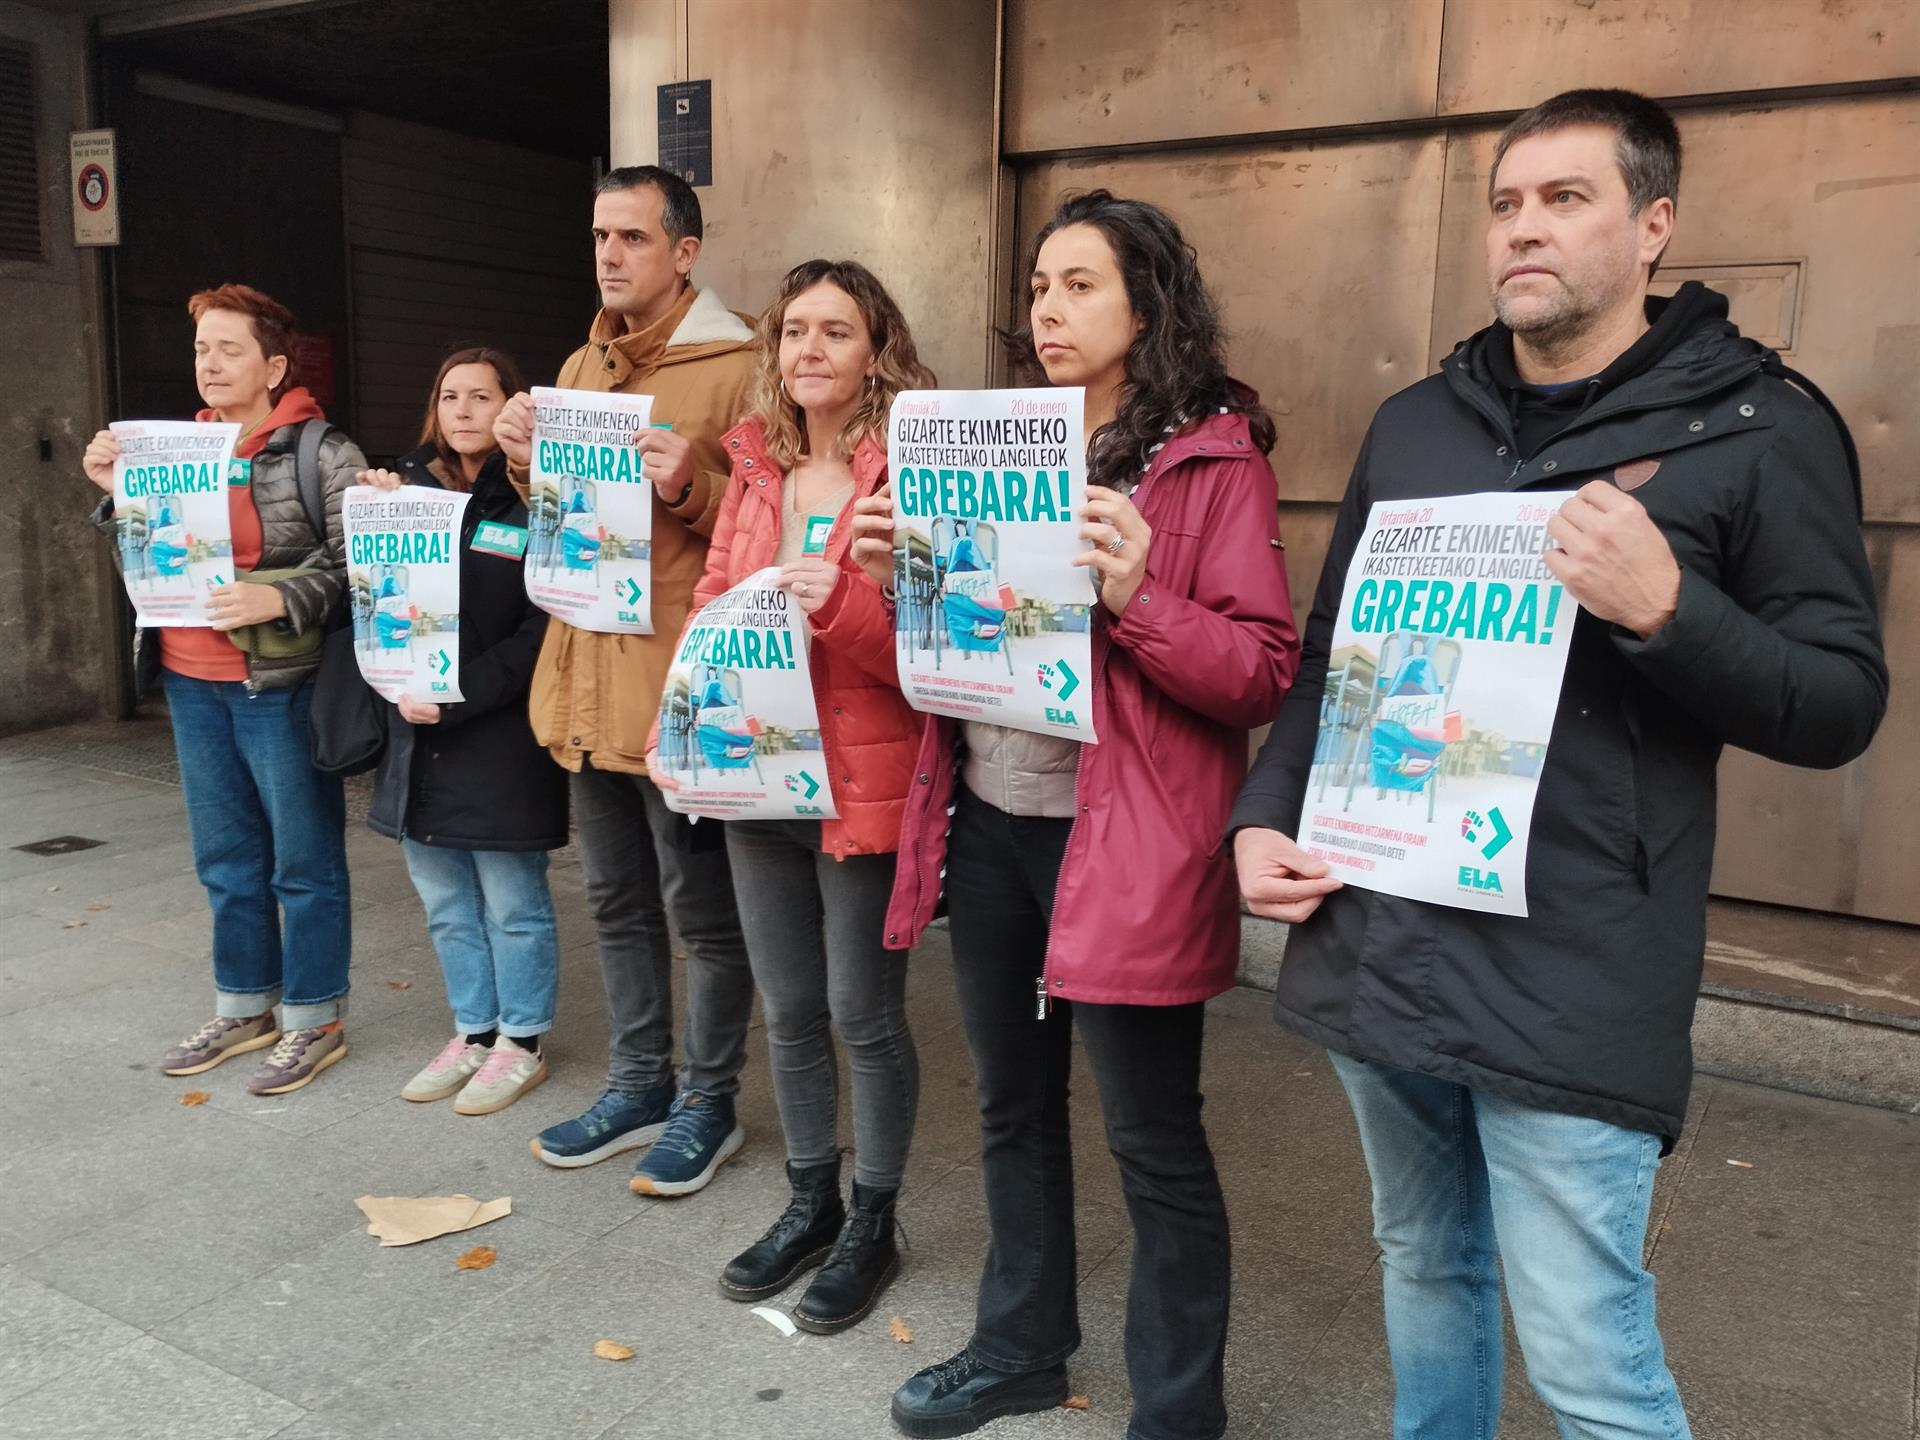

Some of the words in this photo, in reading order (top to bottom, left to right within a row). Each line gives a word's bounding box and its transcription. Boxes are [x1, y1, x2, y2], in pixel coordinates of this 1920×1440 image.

[930, 400, 940, 416] 20
[1011, 400, 1024, 416] 20
[1026, 400, 1038, 415] de
[1039, 402, 1067, 415] enero
[576, 409, 639, 431] EKIMENEKO
[898, 418, 955, 444] GIZARTE
[959, 418, 1067, 445] EKIMENEKO
[540, 440, 641, 484] GREBARA!
[898, 447, 988, 467] IKASTETXEETAKO
[992, 448, 1068, 467] LANGILEOK
[124, 463, 219, 497] GREBARA!
[900, 467, 1071, 522] GREBARA!
[389, 502, 455, 518] EKIMENEKO
[1419, 508, 1434, 522] 20
[1517, 504, 1533, 521] 20
[1533, 505, 1548, 521] de
[480, 525, 519, 549] ELA
[1370, 525, 1446, 554] GIZARTE
[352, 532, 450, 565] GREBARA!
[1362, 556, 1474, 577] IKASTETXEETAKO
[618, 611, 640, 623] ELA
[736, 612, 789, 628] LANGILEOK
[1351, 579, 1563, 645] GREBARA!
[680, 626, 796, 670] GREBARA!
[1045, 708, 1078, 726] ELA
[1458, 865, 1503, 893] ELA
